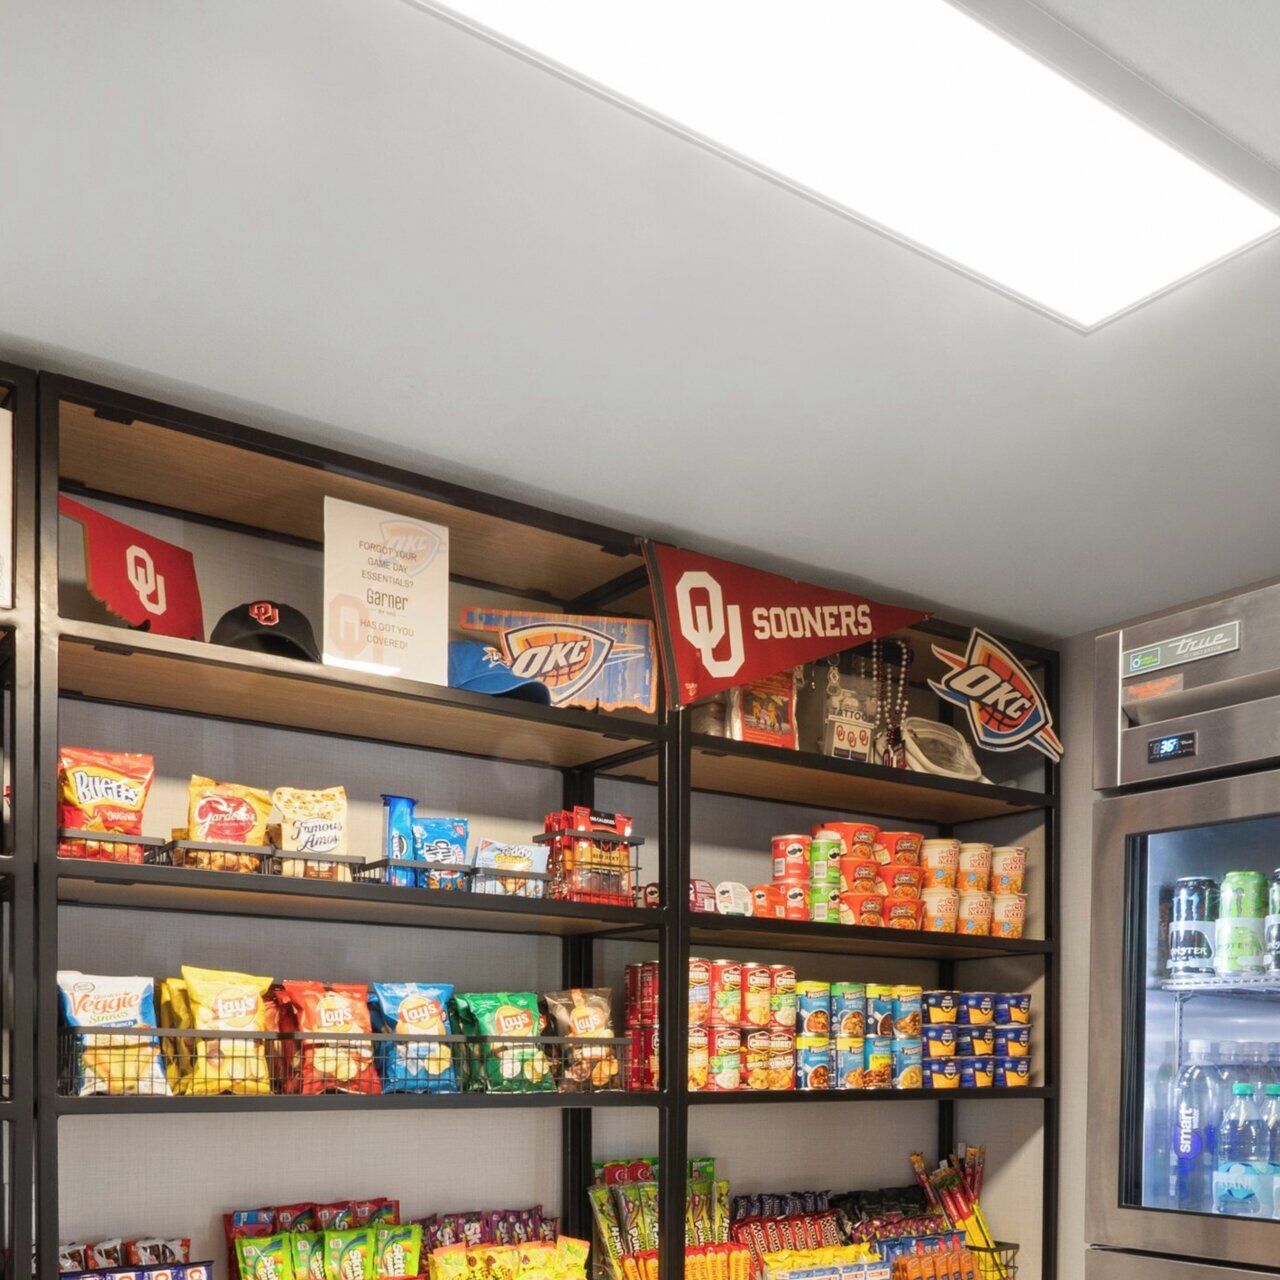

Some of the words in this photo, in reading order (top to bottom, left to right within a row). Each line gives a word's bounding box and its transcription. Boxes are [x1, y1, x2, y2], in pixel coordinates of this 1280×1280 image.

[359, 540, 393, 555] FORGOT
[394, 549, 417, 562] YOUR
[367, 556, 391, 570] GAME
[393, 562, 409, 574] DAY
[125, 544, 168, 616] OU
[361, 570, 414, 588] ESSENTIALS?
[366, 587, 409, 611] Garner
[248, 600, 280, 626] OU
[360, 619, 377, 629] HAS
[378, 622, 395, 632] GOT
[397, 626, 415, 637] YOU
[676, 571, 746, 679] OU
[752, 604, 873, 640] SOONERS
[512, 640, 588, 681] OKC
[953, 666, 1033, 719] OKC
[291, 819, 343, 840] Famous
[297, 832, 340, 852] Amos
[500, 847, 532, 859] Teddy
[70, 991, 141, 1017] Veggie
[401, 1003, 439, 1023] Lay's
[88, 1009, 129, 1025] Straws
[320, 1006, 353, 1027] Lay's
[500, 1012, 530, 1032] Lay's
[1179, 1107, 1193, 1154] smart
